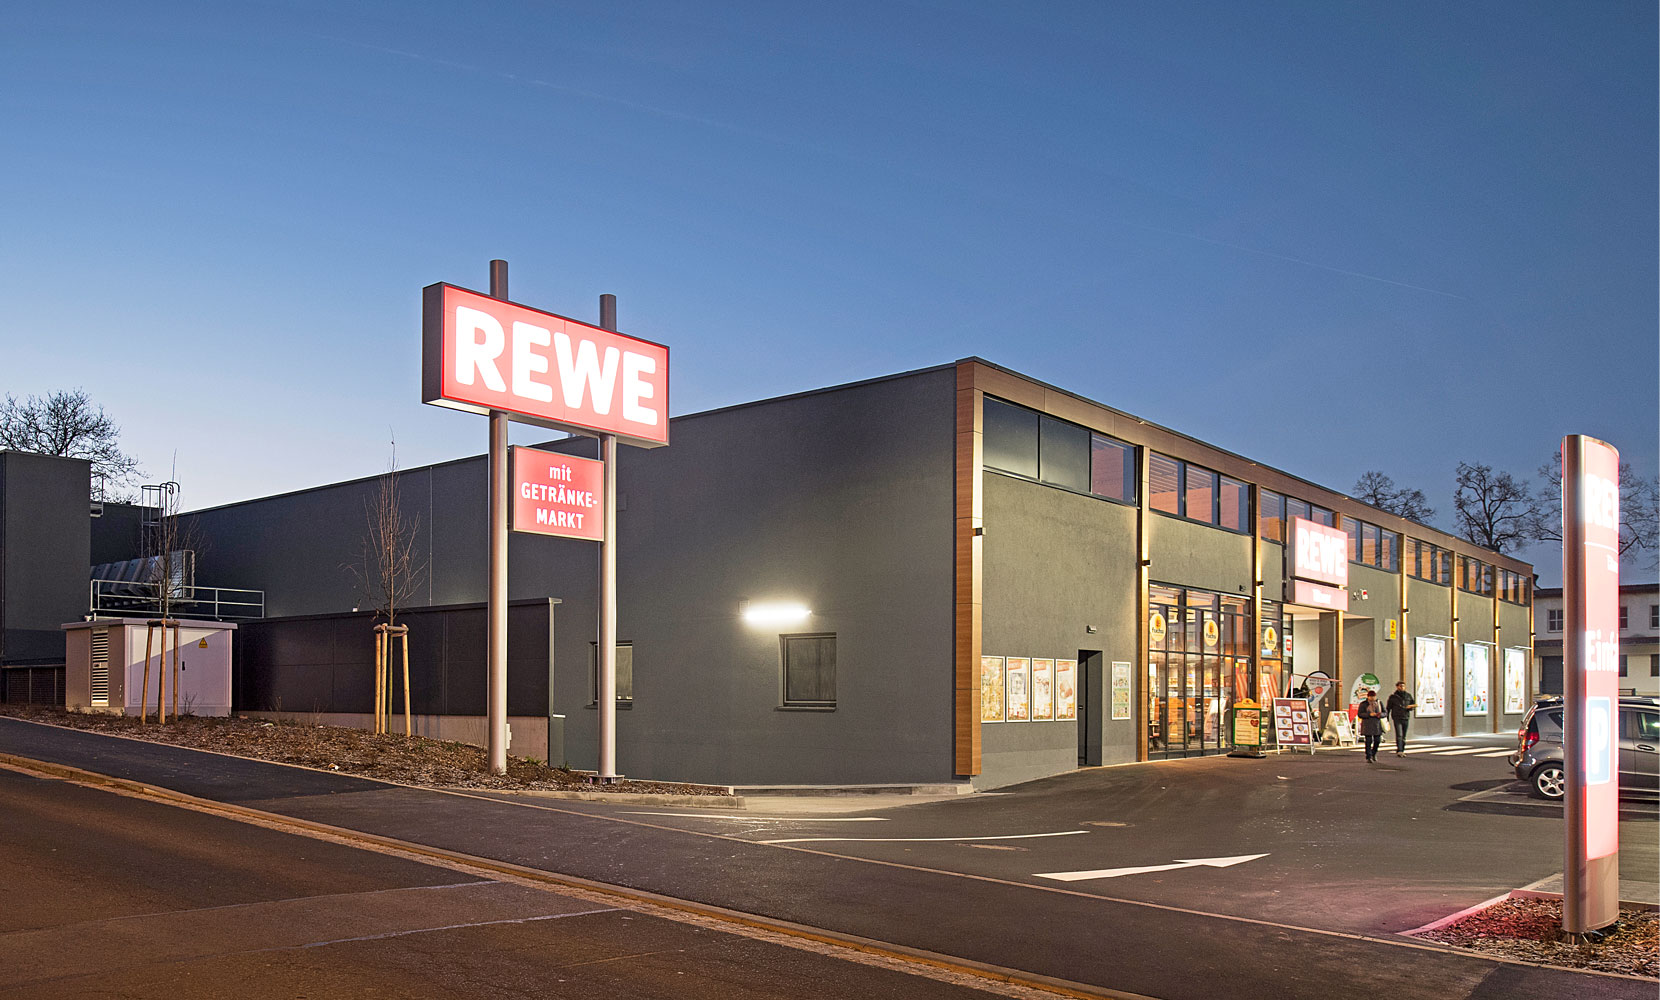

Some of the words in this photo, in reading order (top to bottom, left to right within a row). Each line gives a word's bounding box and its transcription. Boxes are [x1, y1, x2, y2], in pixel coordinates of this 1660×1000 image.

[455, 305, 657, 426] REWE
[549, 464, 572, 482] mit
[521, 482, 598, 508] GETRÄNKE-
[536, 508, 584, 529] MARKT
[1298, 527, 1345, 577] REWE
[1592, 707, 1608, 774] P
